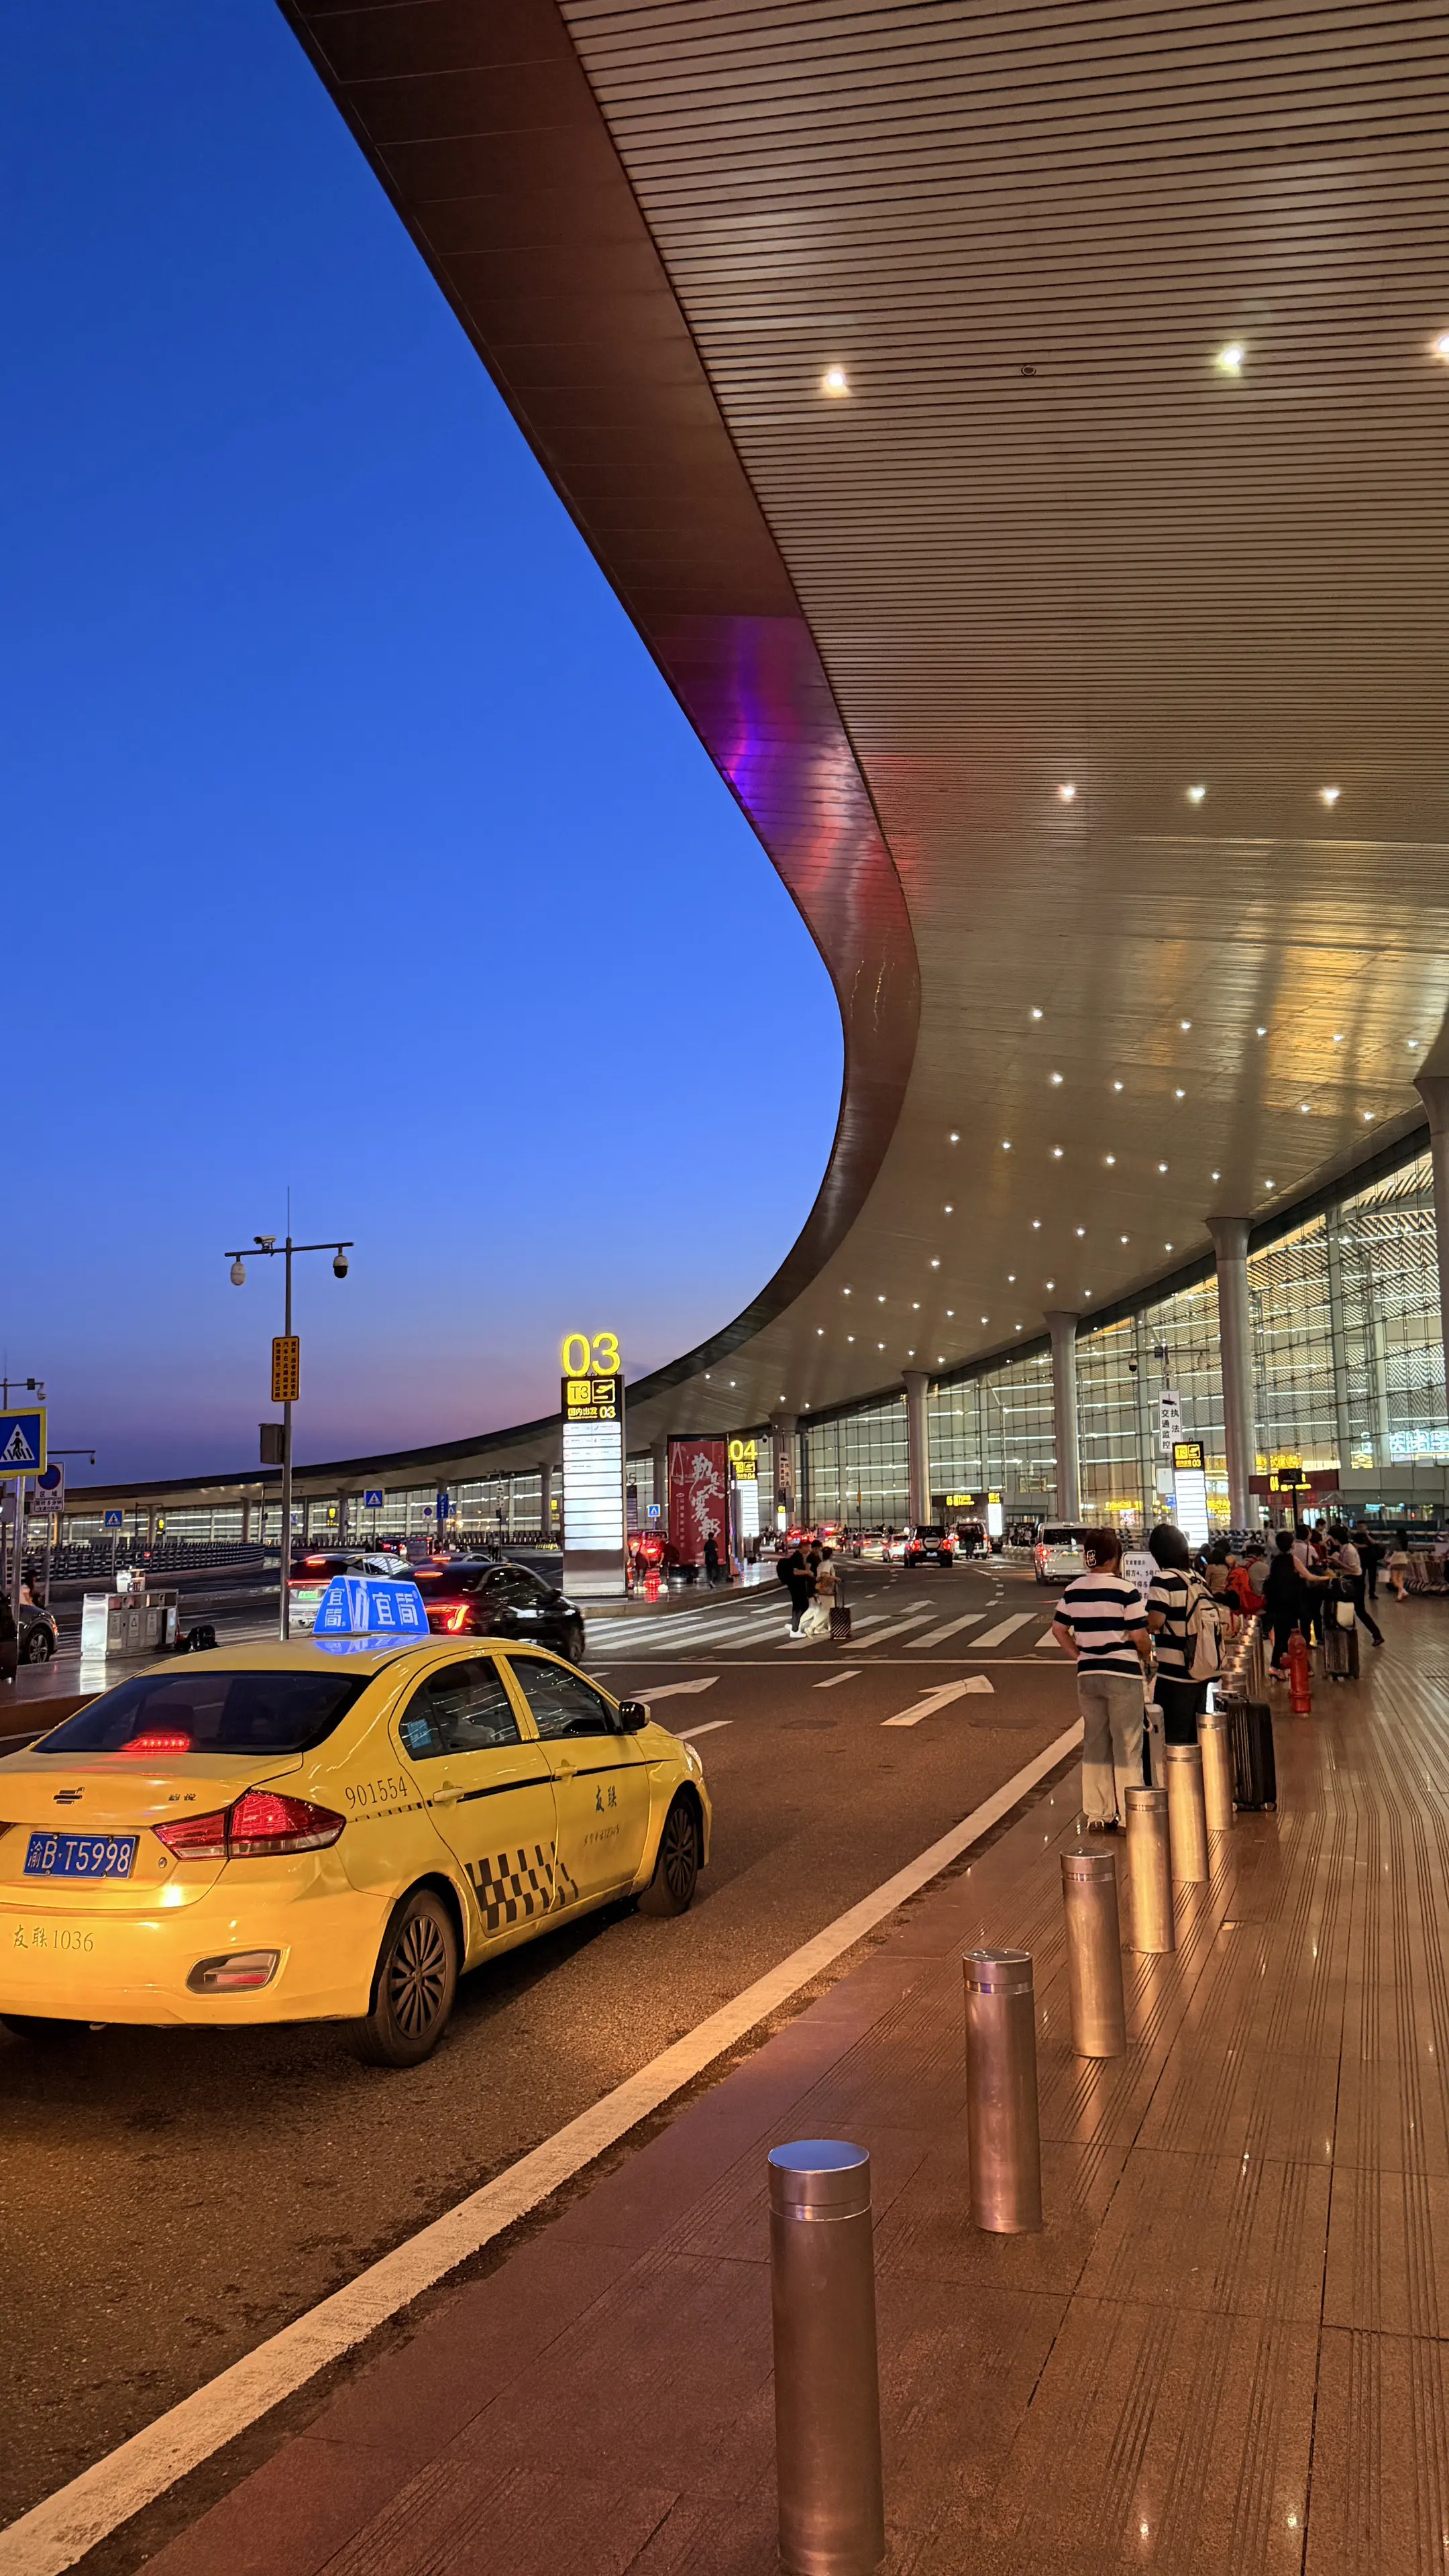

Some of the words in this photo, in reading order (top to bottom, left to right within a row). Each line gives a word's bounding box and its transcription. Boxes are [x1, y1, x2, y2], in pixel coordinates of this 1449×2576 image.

[564, 1332, 621, 1377] 03
[570, 1385, 589, 1399] T3
[568, 1407, 597, 1415] 国内出发
[599, 1406, 616, 1419] 03
[1162, 1409, 1171, 1449] 交通监控
[1171, 1409, 1180, 1442] 执法
[729, 1440, 758, 1461] 04
[1177, 1448, 1187, 1456] T3
[1192, 1459, 1201, 1467] 03
[345, 1776, 407, 1809] 901554
